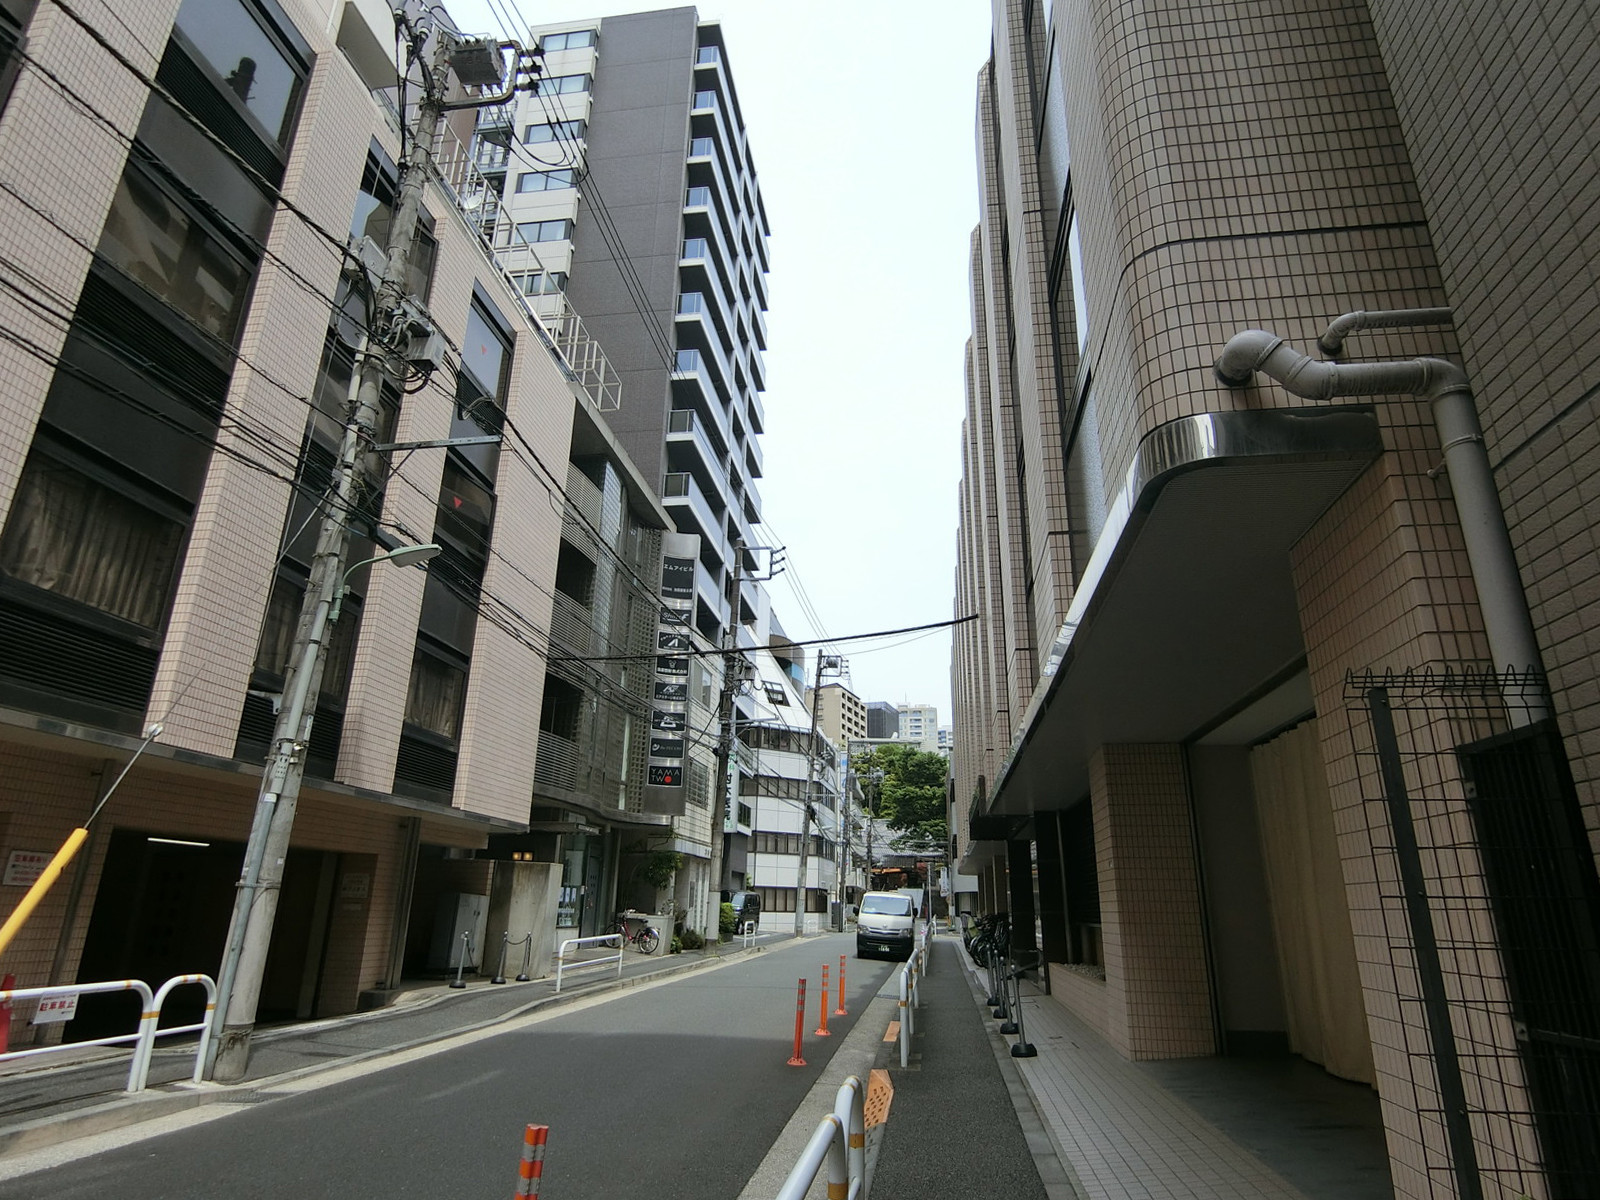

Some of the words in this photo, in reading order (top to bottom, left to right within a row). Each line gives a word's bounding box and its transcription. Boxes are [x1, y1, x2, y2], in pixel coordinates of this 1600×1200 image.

[664, 564, 694, 572] エムアイビル
[40, 1000, 75, 1011] 駐車禁止
